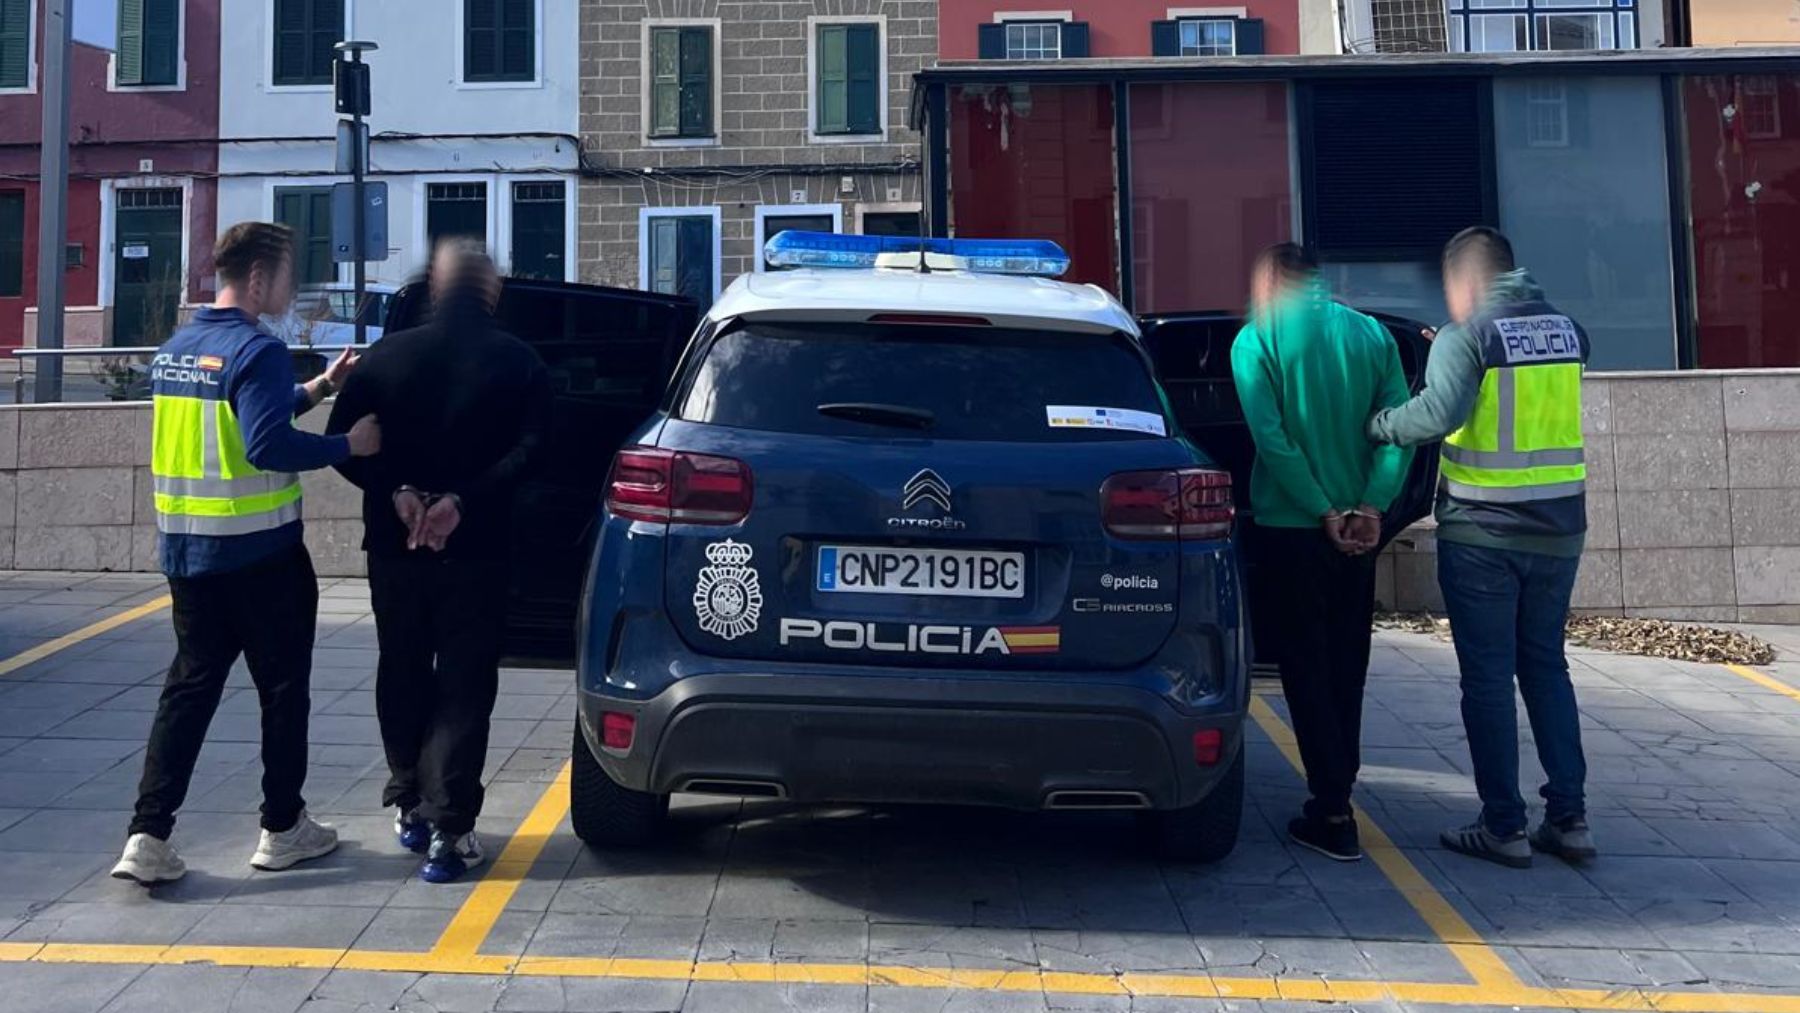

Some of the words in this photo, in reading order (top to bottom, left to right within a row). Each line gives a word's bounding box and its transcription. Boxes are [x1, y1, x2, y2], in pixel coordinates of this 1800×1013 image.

[1506, 333, 1578, 356] POLICIA
[823, 573, 832, 583] E
[840, 553, 1019, 590] CNP2191BC
[1100, 573, 1159, 590] @policia
[1103, 603, 1173, 612] AIRCROSS
